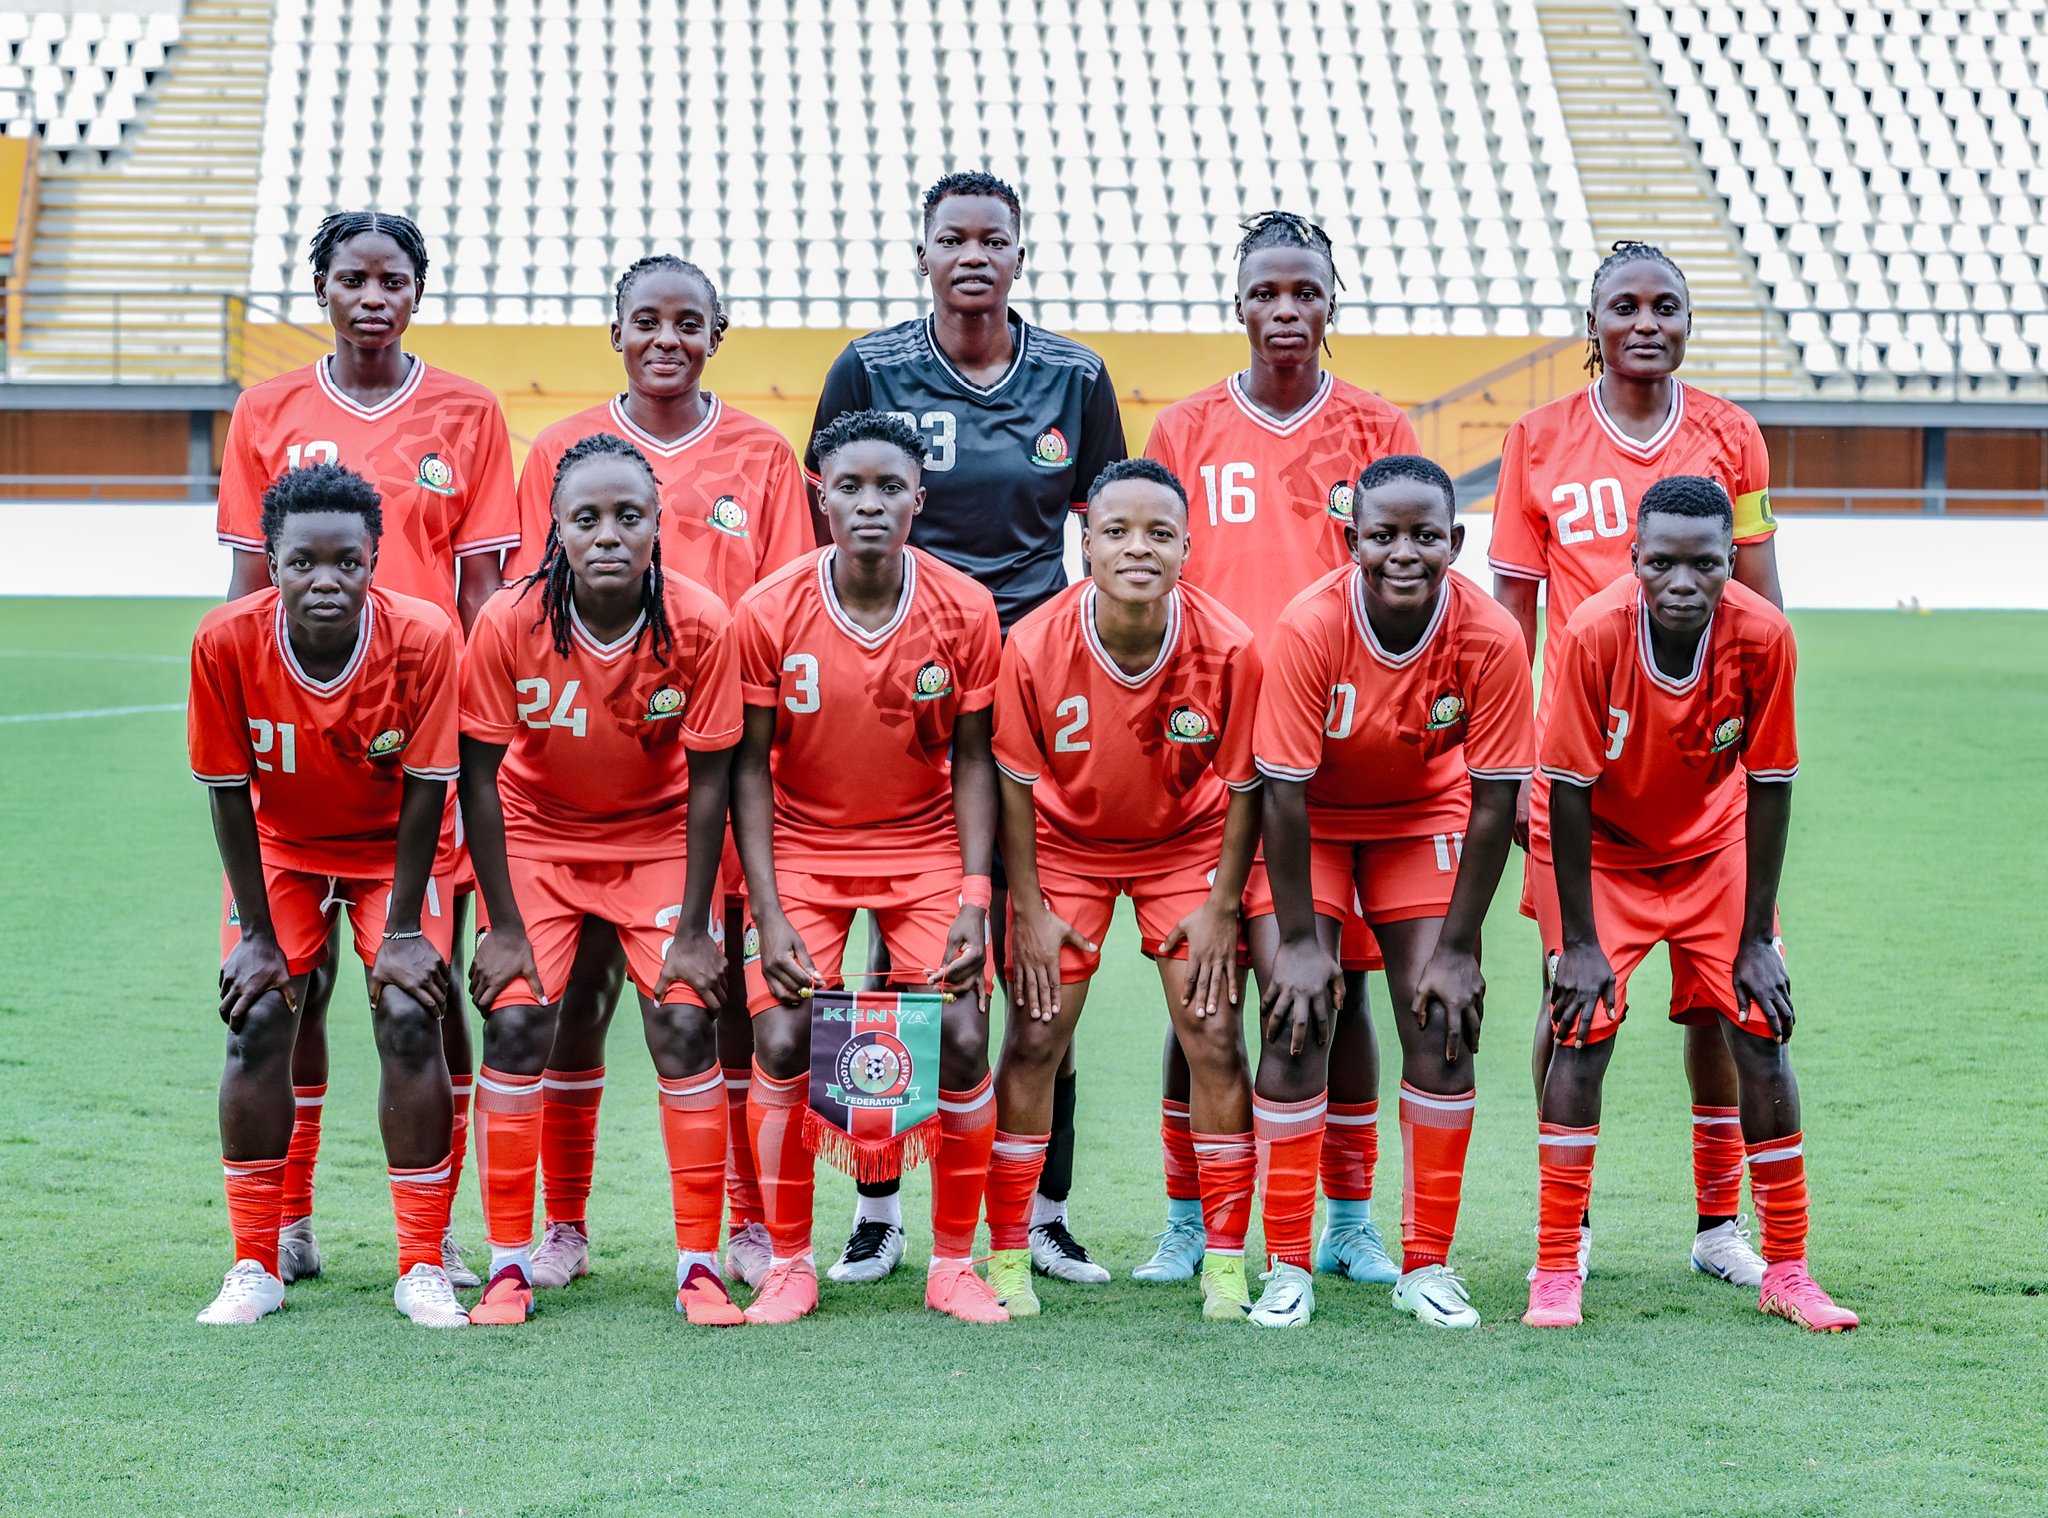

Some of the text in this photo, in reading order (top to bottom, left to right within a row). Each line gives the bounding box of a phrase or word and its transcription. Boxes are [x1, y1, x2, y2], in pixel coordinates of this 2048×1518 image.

[1200, 462, 1256, 527] 16
[1552, 478, 1629, 546] 20
[516, 677, 587, 737] 24
[783, 653, 820, 713] 3
[248, 717, 296, 774] 21
[1055, 695, 1090, 753] 2
[823, 1008, 929, 1025] KENYA
[840, 1042, 861, 1090] FOOTBALL
[898, 1050, 910, 1086] KENYA
[845, 1095, 903, 1106] FEDERATION
